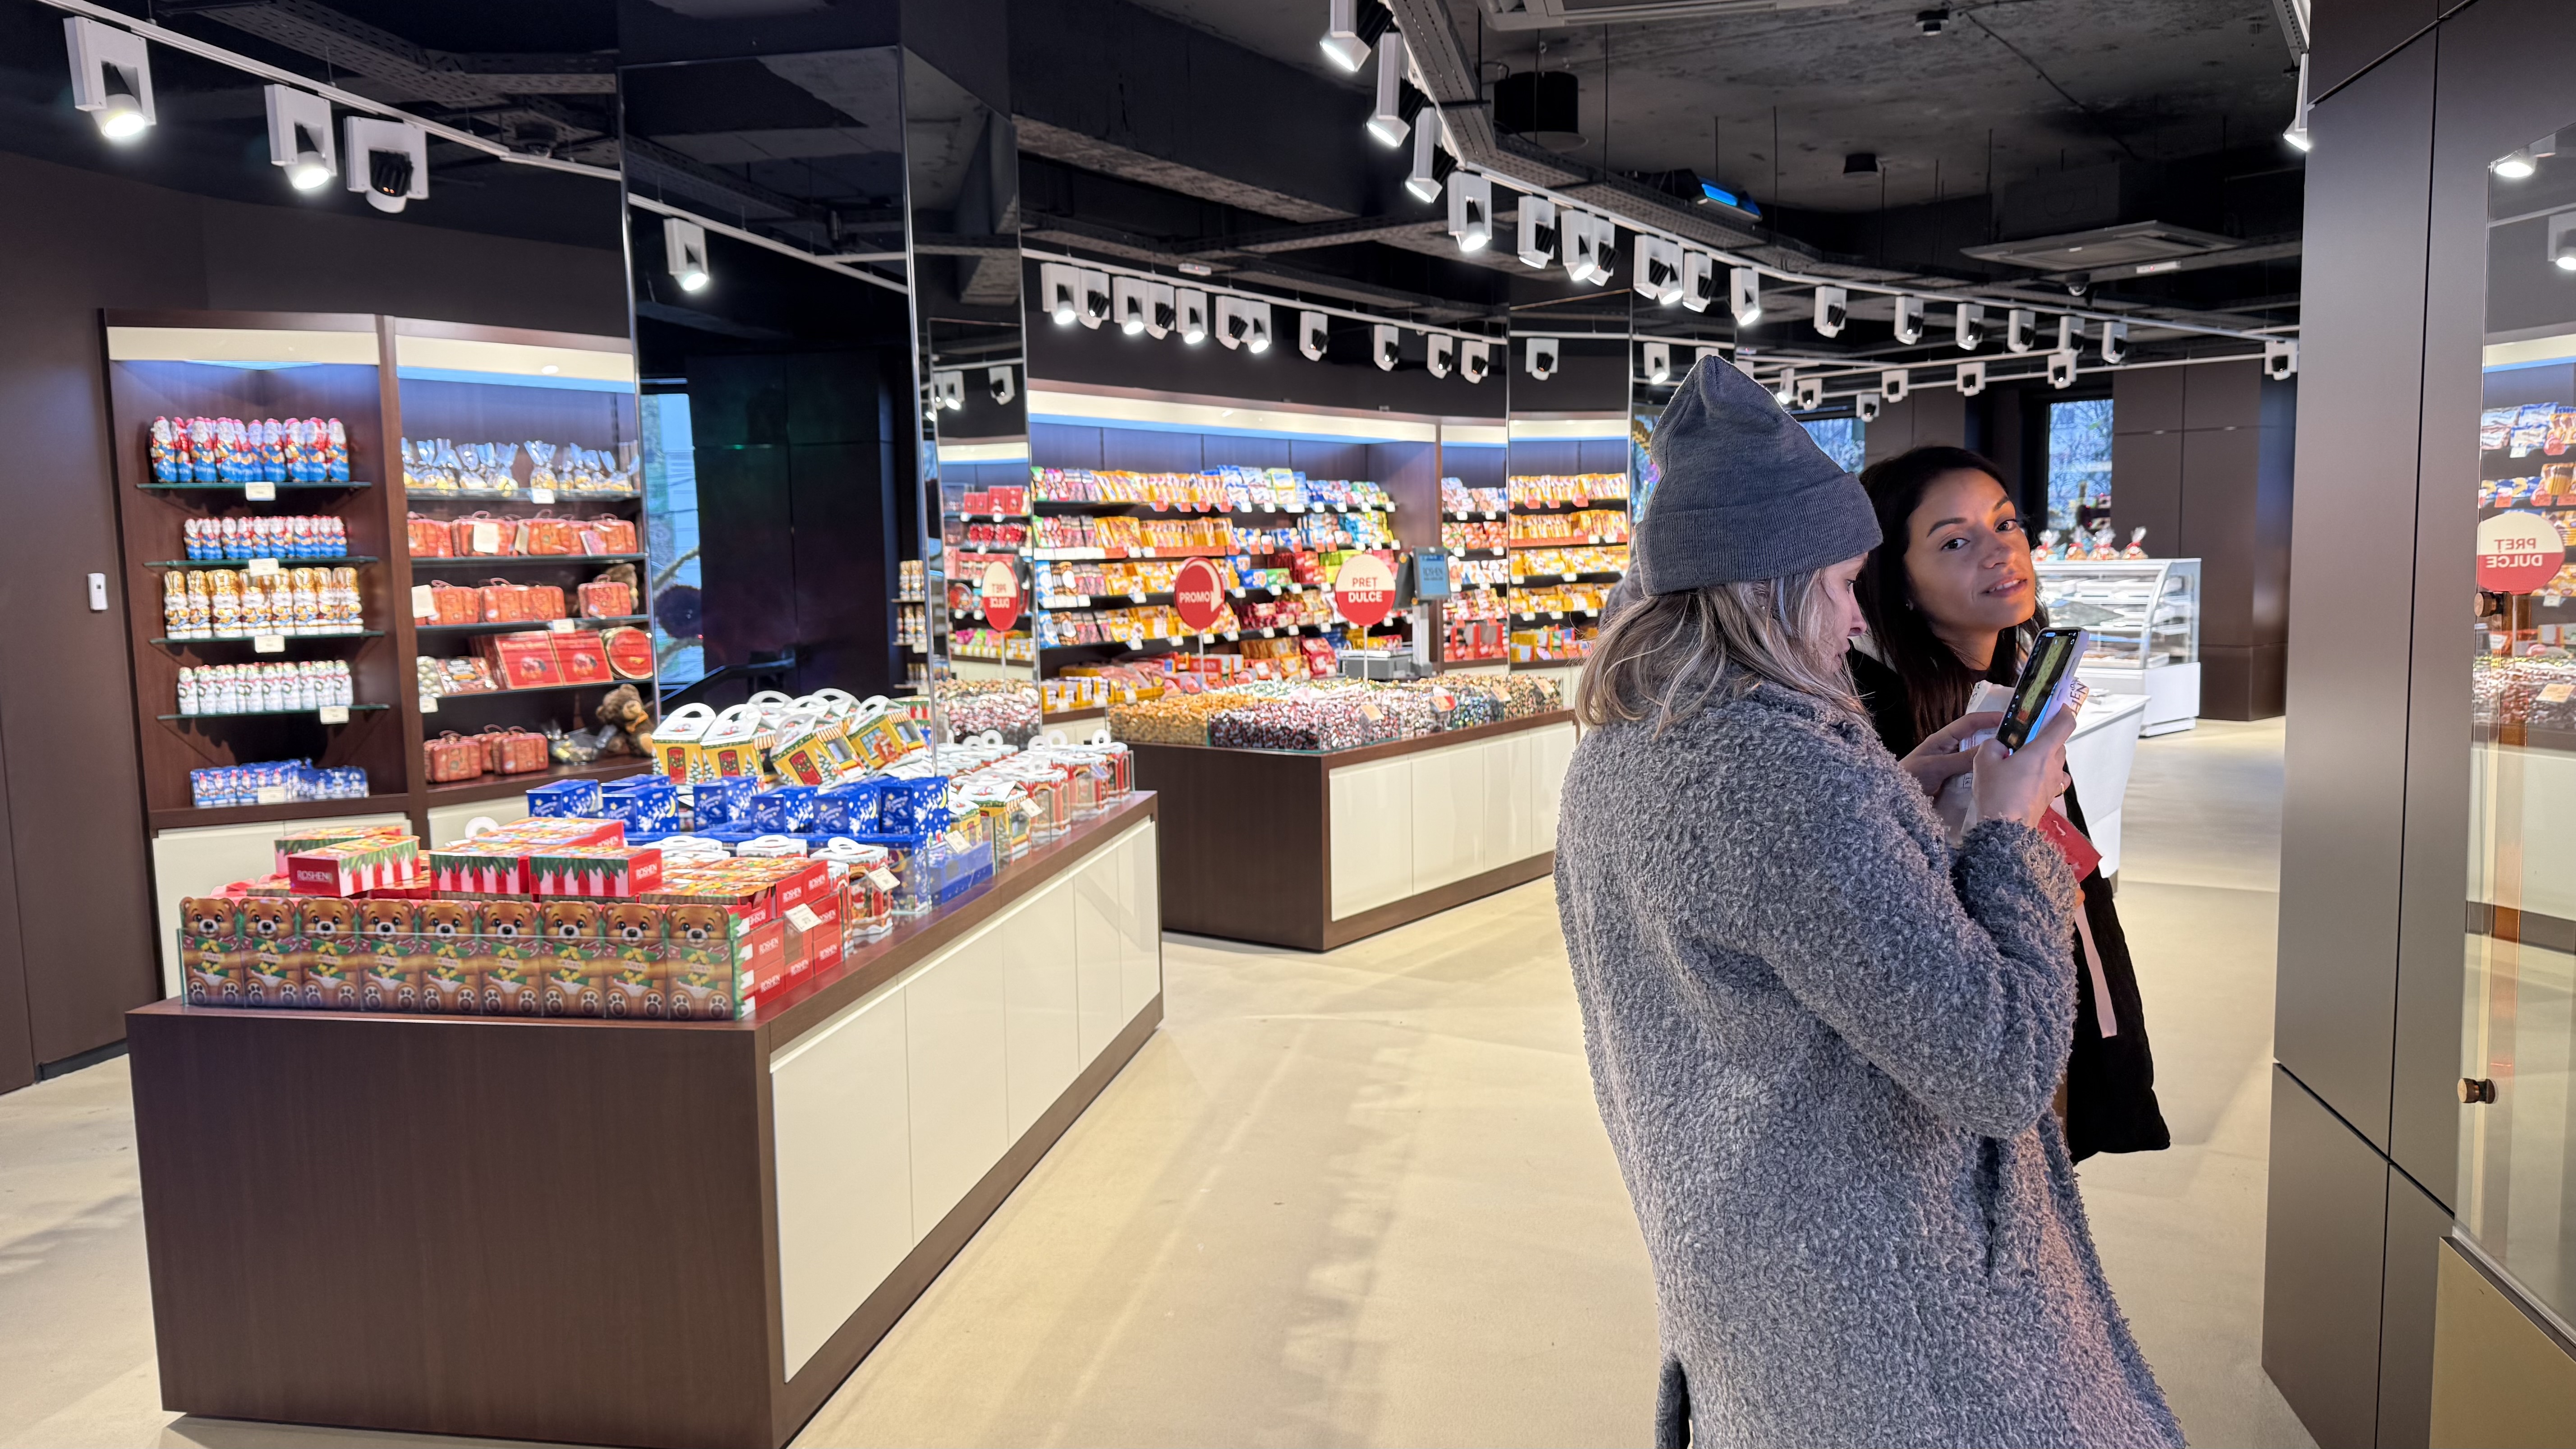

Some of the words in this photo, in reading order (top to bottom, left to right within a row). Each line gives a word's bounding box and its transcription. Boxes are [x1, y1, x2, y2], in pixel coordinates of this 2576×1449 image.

[1352, 577, 1378, 589] PREȚ
[1348, 591, 1383, 603] DULCE
[297, 870, 333, 883] ROSHEN
[636, 863, 657, 880] ROSHEN
[783, 886, 801, 903] ROSHEN
[759, 936, 779, 955] ROSHEN
[819, 943, 838, 961] ROSHEN
[791, 958, 810, 977] ROSHEN
[760, 974, 780, 993] ROSHEN
